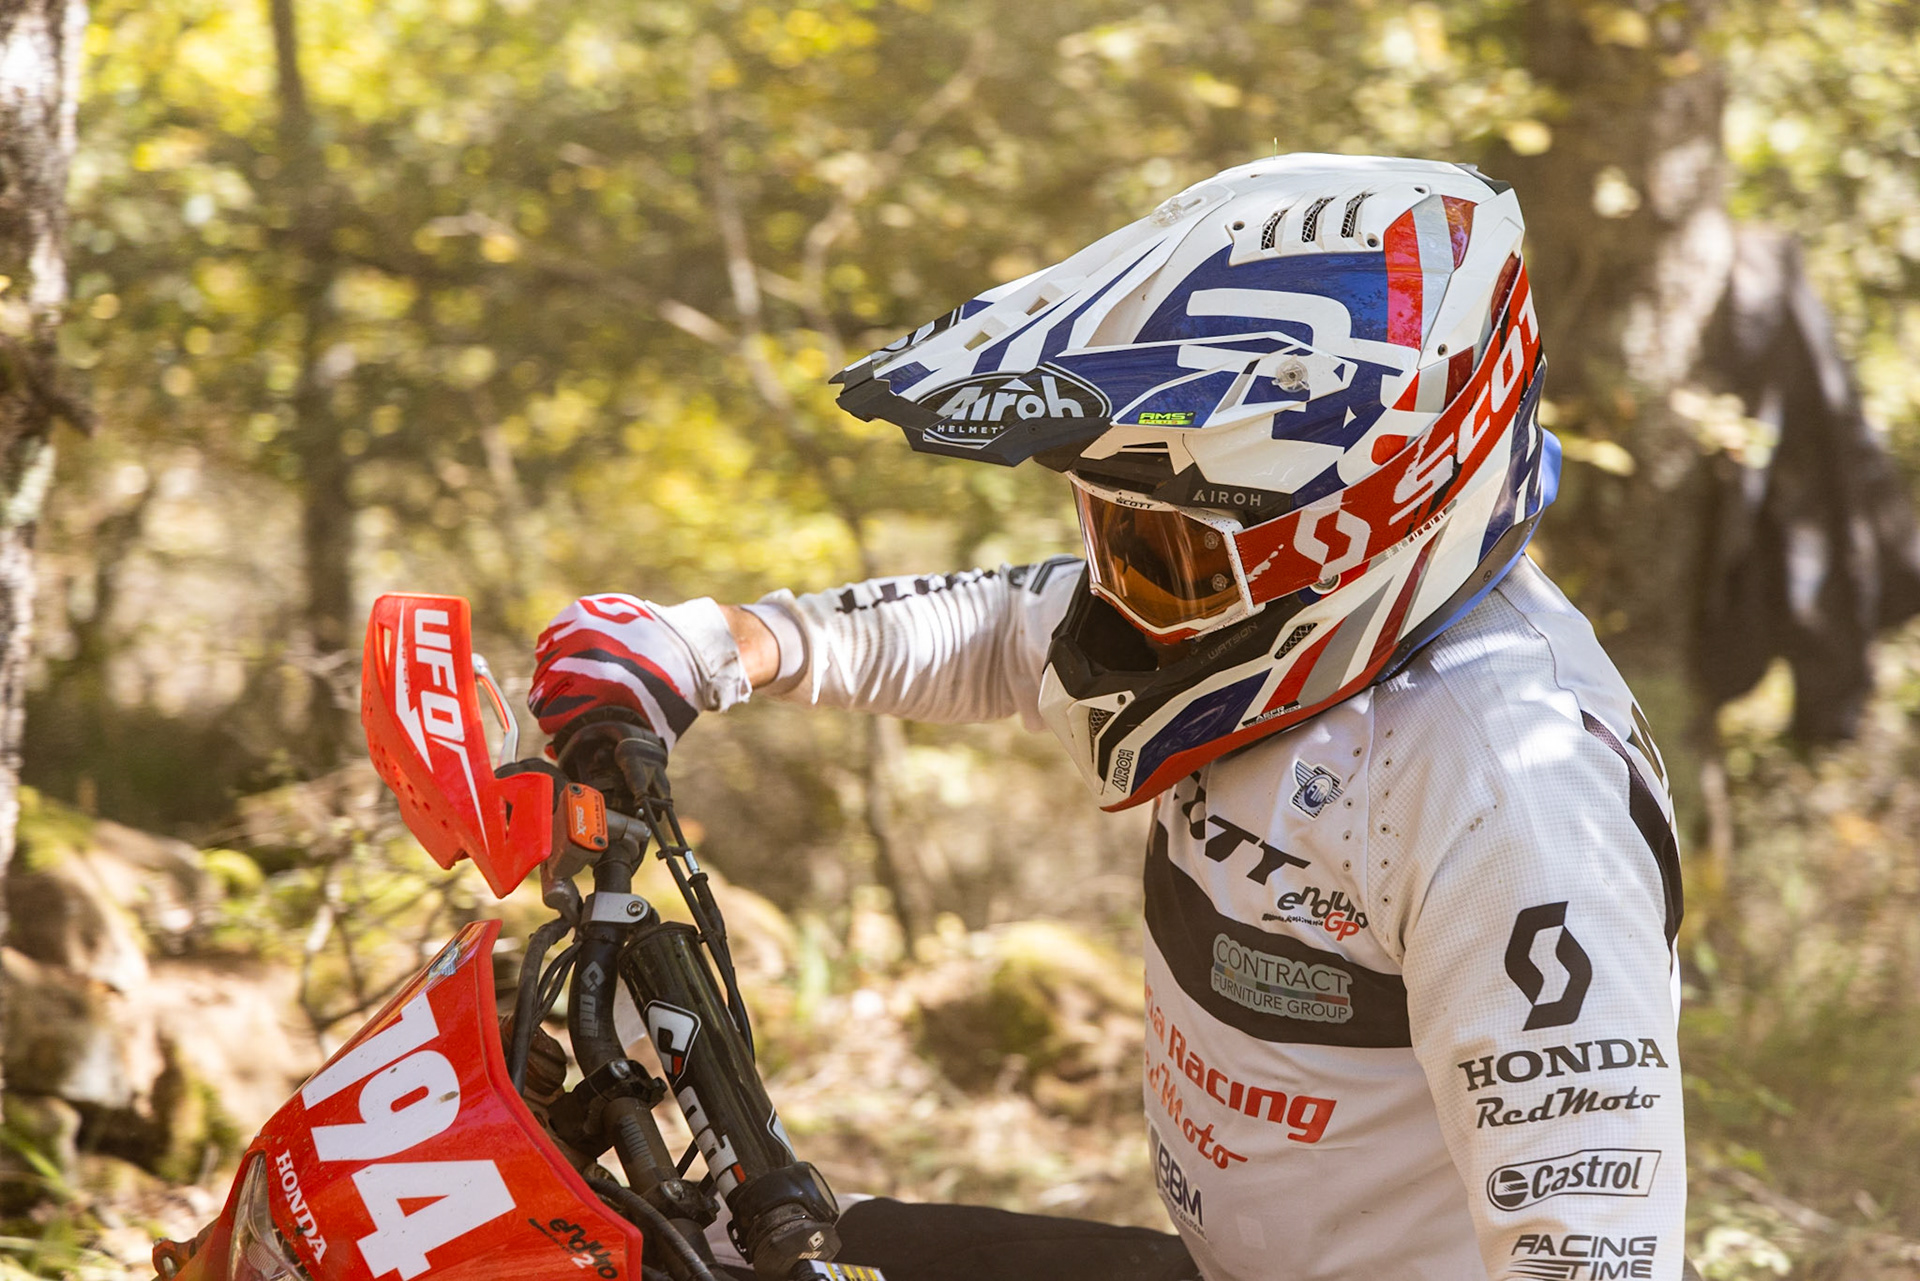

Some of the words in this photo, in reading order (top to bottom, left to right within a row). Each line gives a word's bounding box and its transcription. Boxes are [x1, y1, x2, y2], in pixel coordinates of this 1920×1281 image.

[936, 425, 1000, 435] HELMET
[1115, 497, 1154, 510] SCOTT
[1192, 489, 1262, 507] AIROH
[1207, 621, 1259, 660] WATSON
[414, 608, 466, 743] UFO
[1112, 748, 1135, 793] AIROH
[1322, 911, 1360, 942] GP
[1216, 939, 1348, 994] CONTRACT
[1213, 972, 1283, 1010] FURNITURE
[1287, 999, 1348, 1020] GROUP
[1168, 1023, 1338, 1144] Racing
[1457, 1038, 1669, 1092] HONDA
[301, 992, 517, 1281] 194
[1158, 1142, 1204, 1227] BBM
[1531, 1155, 1643, 1199] Castrol
[275, 1149, 328, 1265] HONDA
[1511, 1233, 1658, 1258] RACING
[1545, 1258, 1653, 1281] TIME
